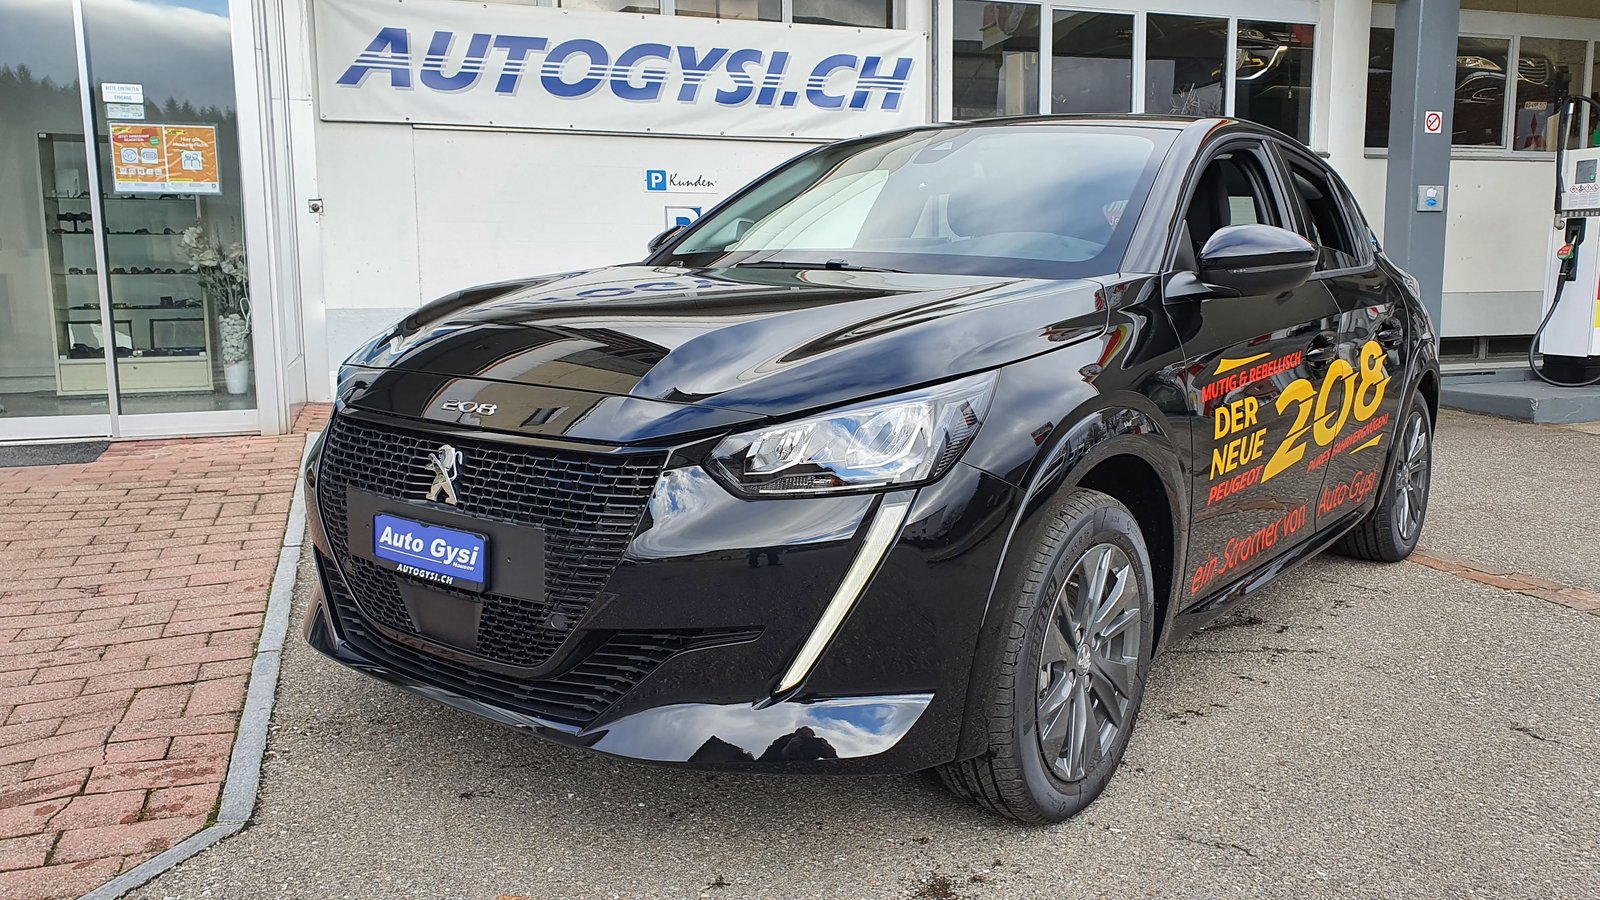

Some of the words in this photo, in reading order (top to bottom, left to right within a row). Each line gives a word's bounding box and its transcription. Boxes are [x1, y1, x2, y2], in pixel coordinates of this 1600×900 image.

[336, 26, 914, 112] AUTOGYSI.CH
[669, 173, 715, 188] Kunden
[1201, 373, 1237, 403] MUTIG
[1239, 371, 1247, 386] &
[1249, 351, 1302, 384] REBELLISCH
[441, 399, 498, 416] 208
[1214, 396, 1259, 441] DER
[1260, 340, 1392, 484] 208
[1209, 428, 1267, 481] NEUE
[1207, 464, 1264, 506] PEUGEOT
[379, 526, 424, 553] Auto
[430, 538, 480, 566] Gysi
[1190, 552, 1218, 596] ein
[1218, 517, 1281, 576] Stromer
[1283, 504, 1307, 537] von
[1317, 483, 1350, 517] Auto
[1348, 467, 1378, 503] Gysi
[396, 564, 454, 585] AUTOGYSI.CH
[452, 562, 475, 572] Hausen
